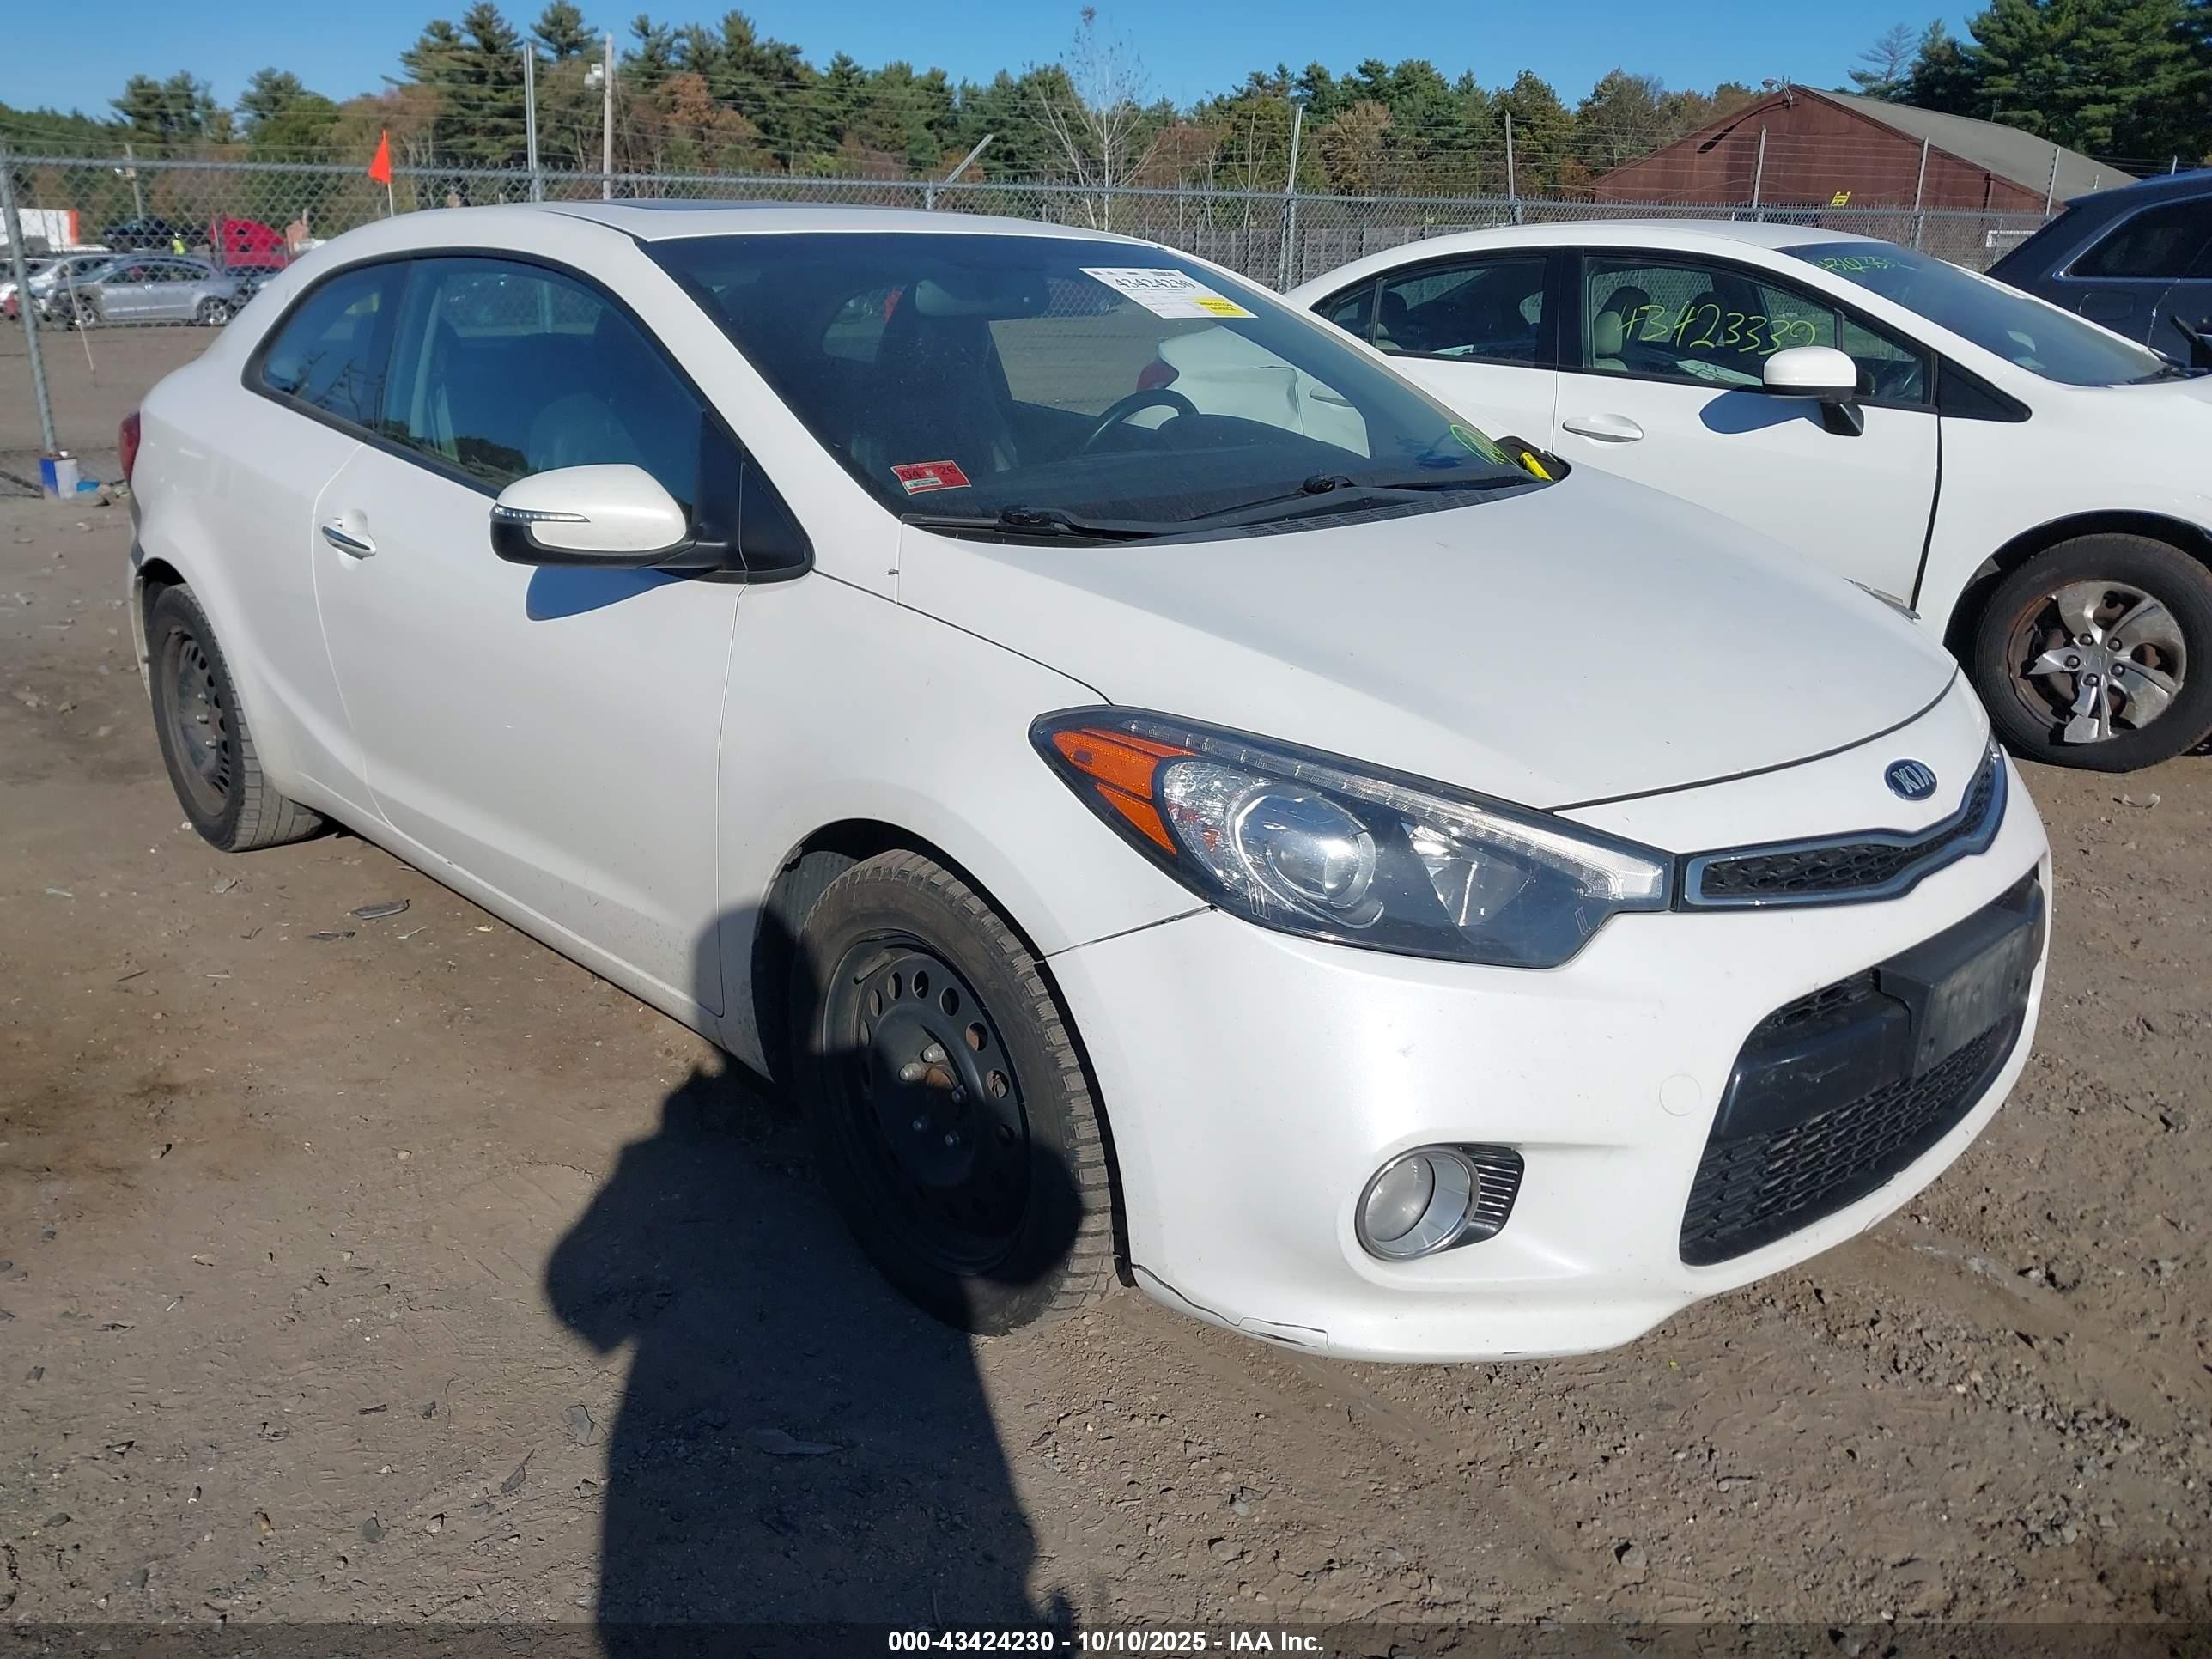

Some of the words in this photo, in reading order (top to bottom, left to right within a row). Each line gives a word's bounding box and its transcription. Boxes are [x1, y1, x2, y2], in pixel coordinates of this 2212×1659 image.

[1115, 278, 1196, 289] 43424230
[902, 470, 921, 479] 04
[939, 465, 957, 474] 26
[1892, 763, 1936, 793] KIA
